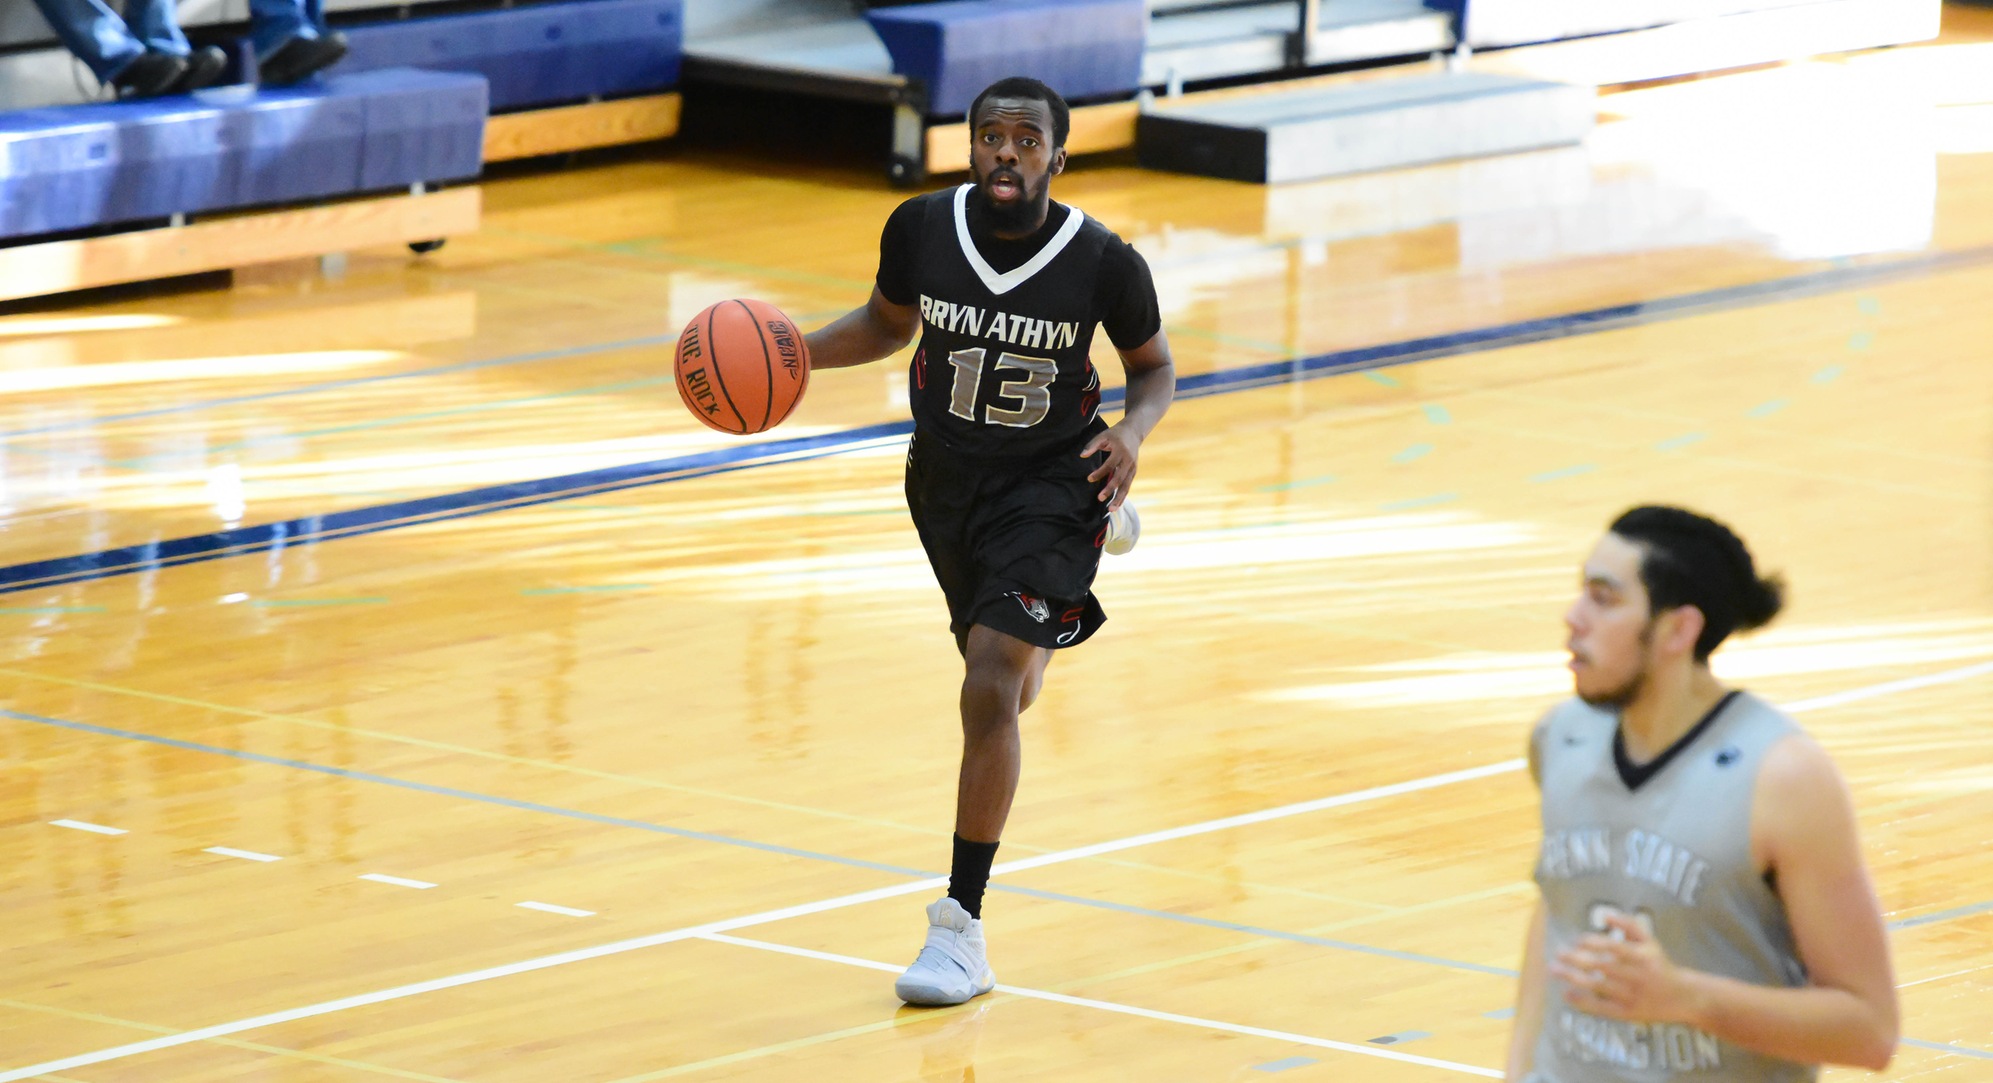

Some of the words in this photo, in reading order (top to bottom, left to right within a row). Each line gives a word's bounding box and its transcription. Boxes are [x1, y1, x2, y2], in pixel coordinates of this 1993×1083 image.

[682, 324, 702, 365] THE
[919, 293, 986, 337] BRYN
[984, 311, 1080, 350] ATHYN
[686, 367, 721, 416] ROCK
[947, 347, 1059, 428] 13
[1623, 826, 1710, 906] STATE
